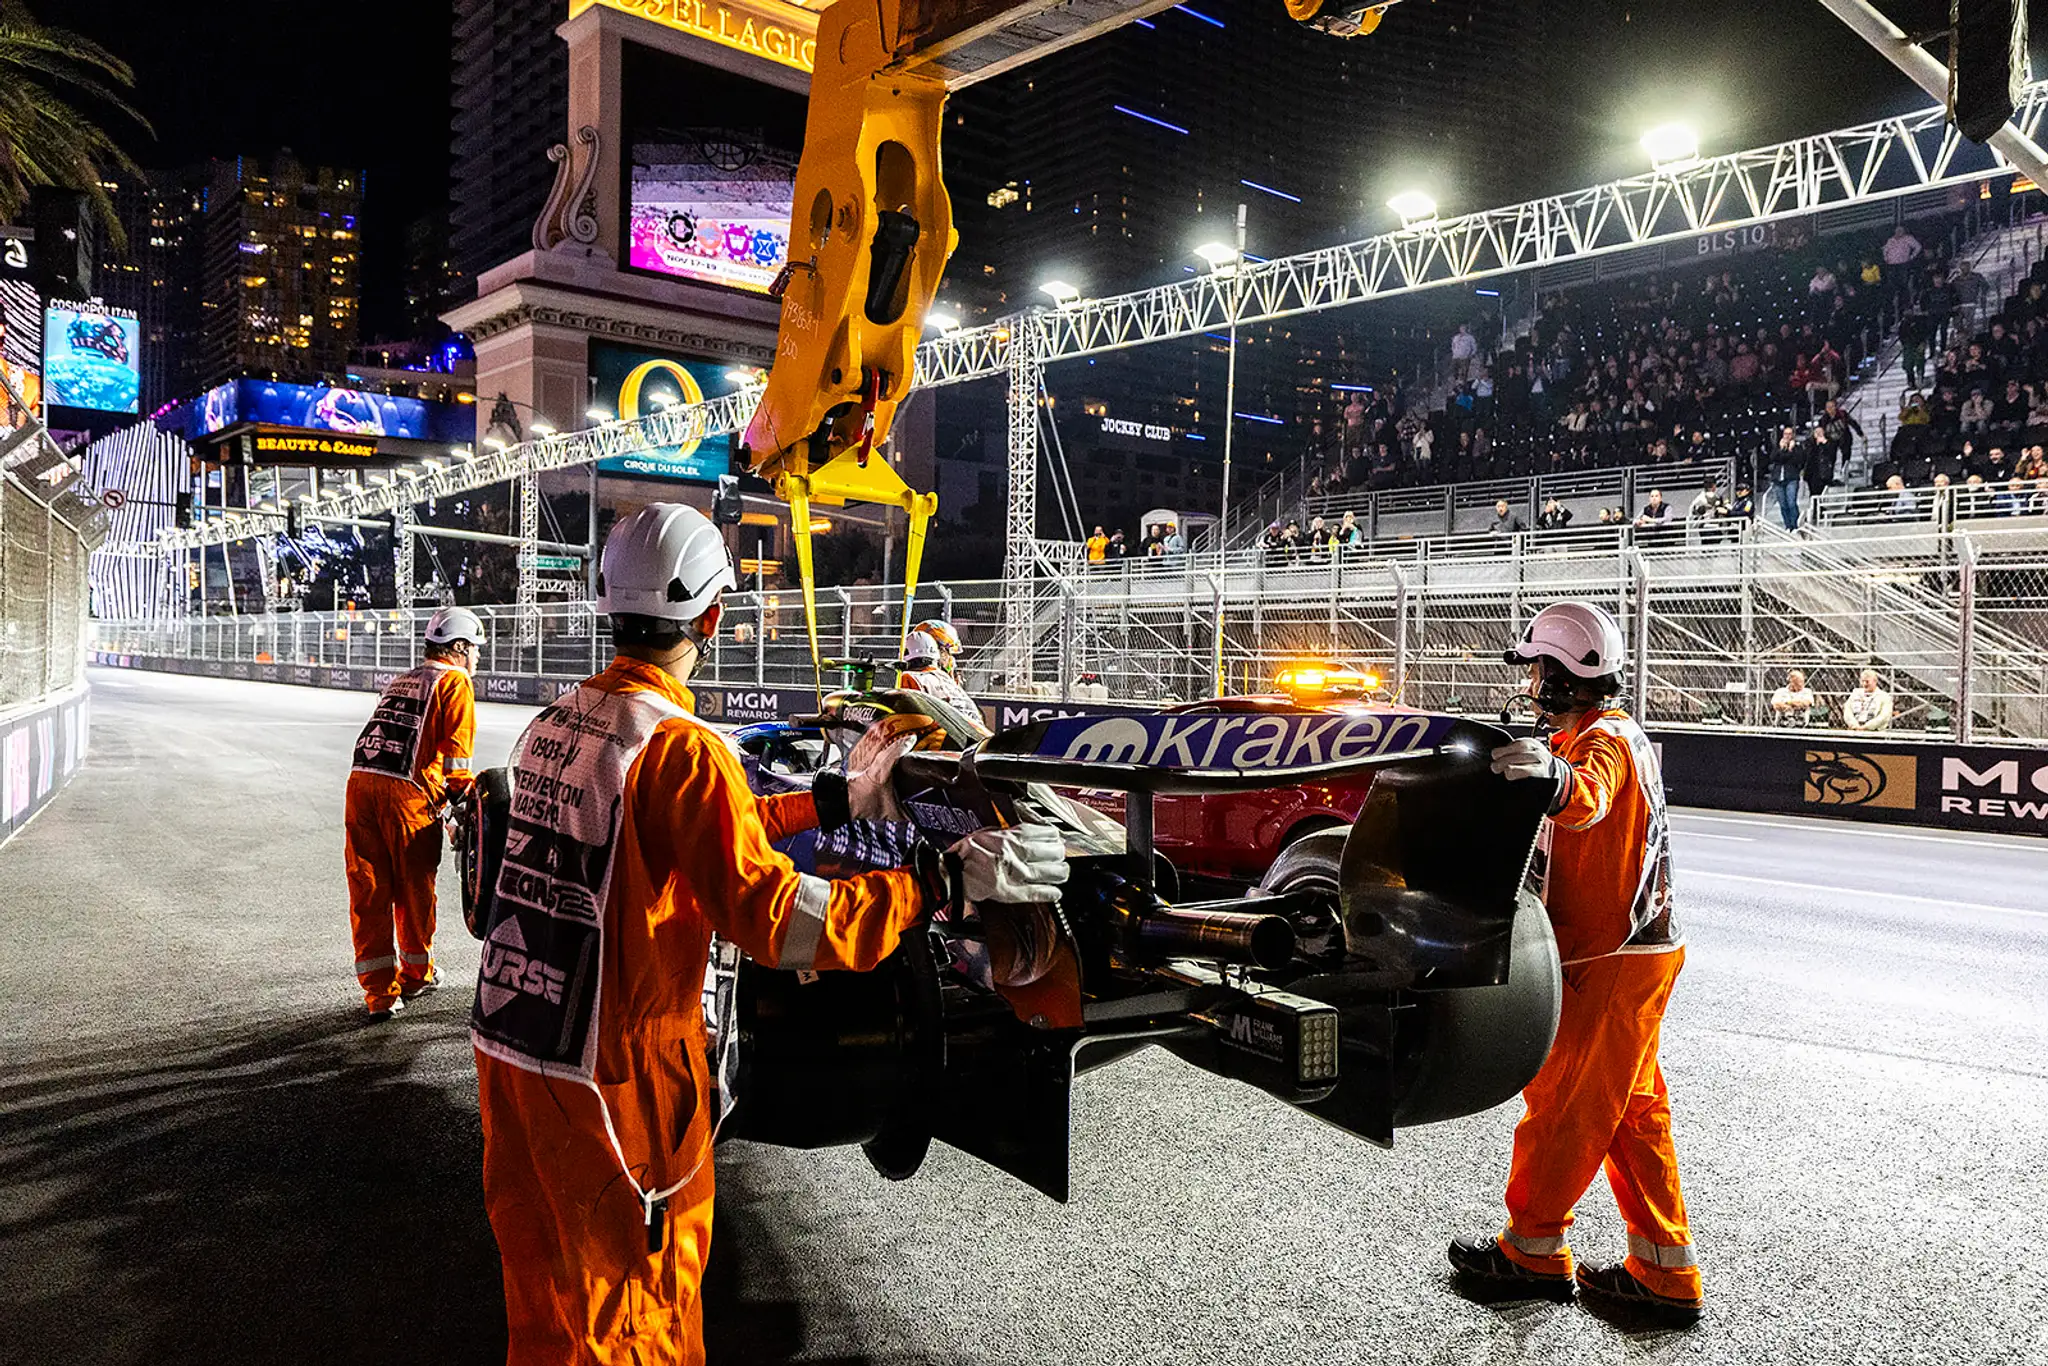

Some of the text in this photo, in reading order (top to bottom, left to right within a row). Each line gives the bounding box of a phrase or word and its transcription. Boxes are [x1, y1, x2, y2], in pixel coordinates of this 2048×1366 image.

[1698, 230, 1736, 255] BLS
[50, 298, 138, 319] COSMOPOLITAN
[1101, 418, 1171, 441] JOCKEY CLUB
[257, 438, 319, 451] BEAUTY
[319, 441, 332, 452] &
[624, 460, 700, 476] CIRQUE DU SOLEIL
[487, 679, 518, 692] MGM
[727, 692, 778, 709] MGM
[727, 709, 778, 720] REWARDS
